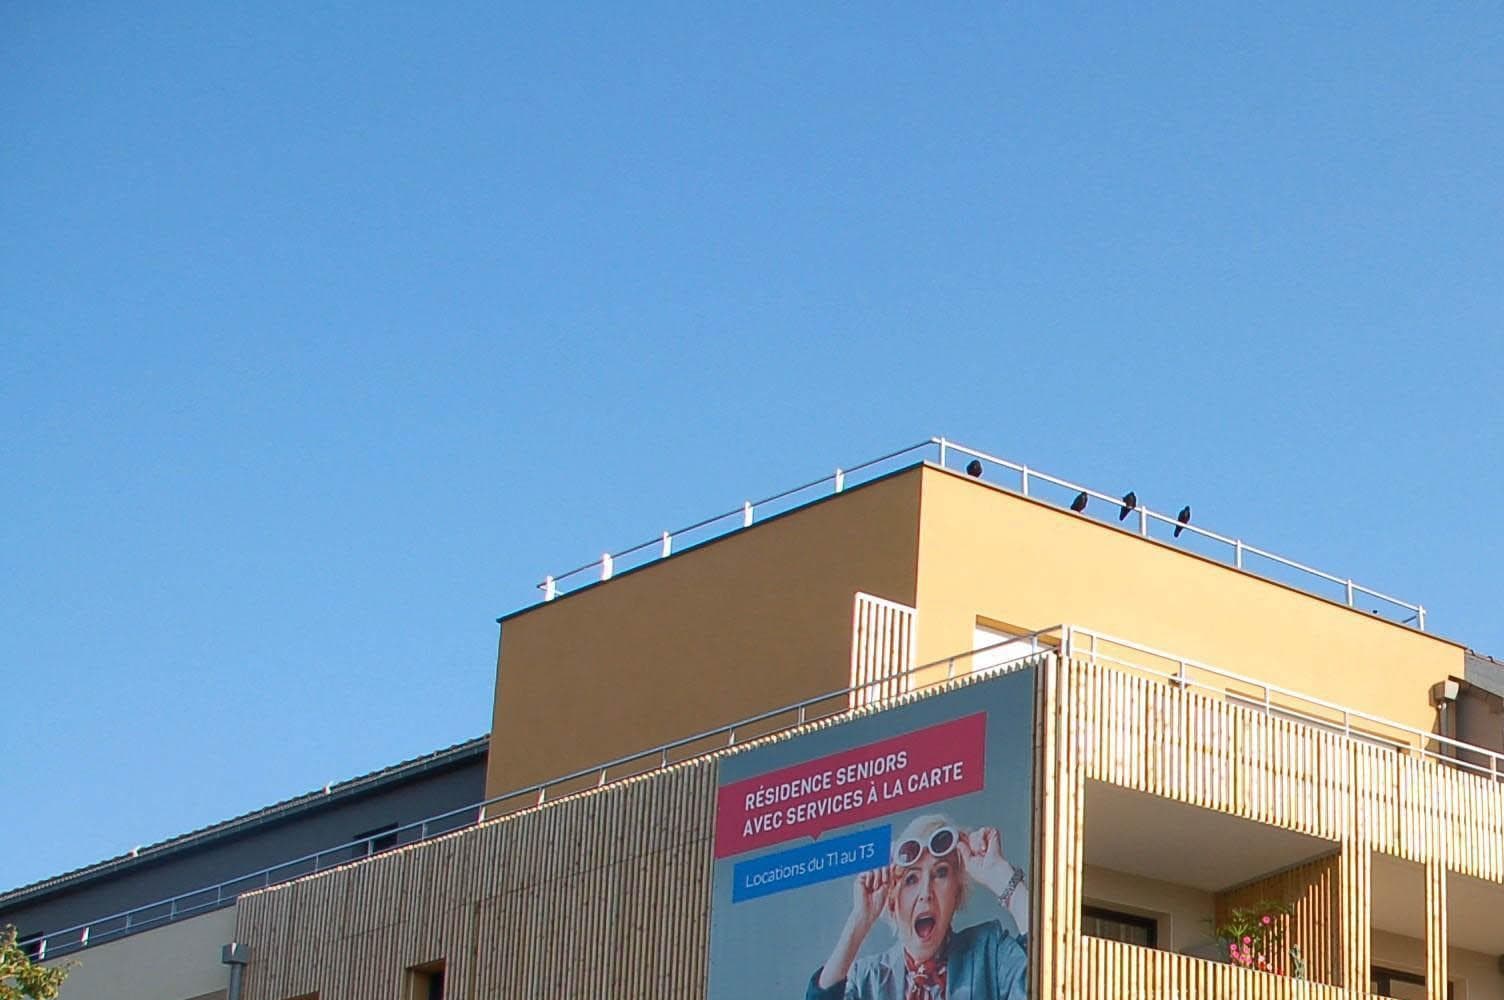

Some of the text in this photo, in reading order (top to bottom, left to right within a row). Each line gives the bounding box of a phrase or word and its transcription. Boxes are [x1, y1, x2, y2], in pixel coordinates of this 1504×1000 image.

[743, 761, 964, 837] AVEC SERVICES À LA CARTE
[745, 751, 908, 811] RÉSIDENCE SENIORS
[745, 862, 806, 888] Locations
[808, 855, 824, 872] du
[840, 850, 857, 865] au
[859, 842, 875, 860] T3
